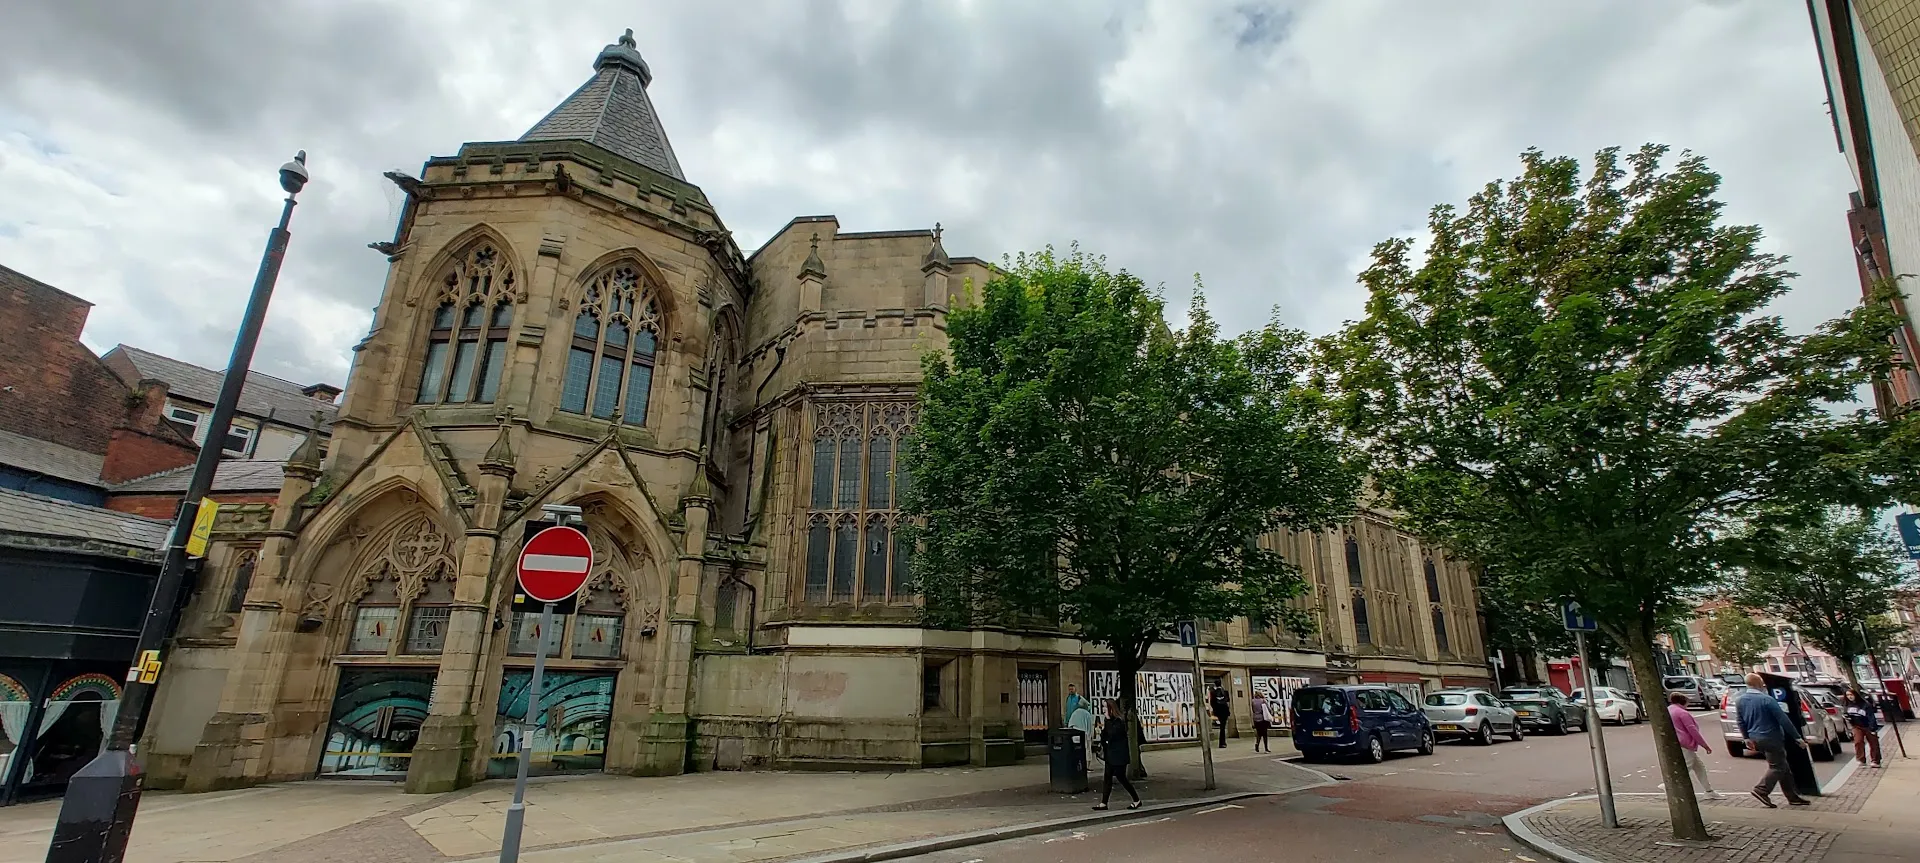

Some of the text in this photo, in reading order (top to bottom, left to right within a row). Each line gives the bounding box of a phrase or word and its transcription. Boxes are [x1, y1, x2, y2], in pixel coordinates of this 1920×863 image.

[143, 663, 159, 681] H
[1091, 672, 1154, 697] IMAINE
[1773, 688, 1783, 700] P
